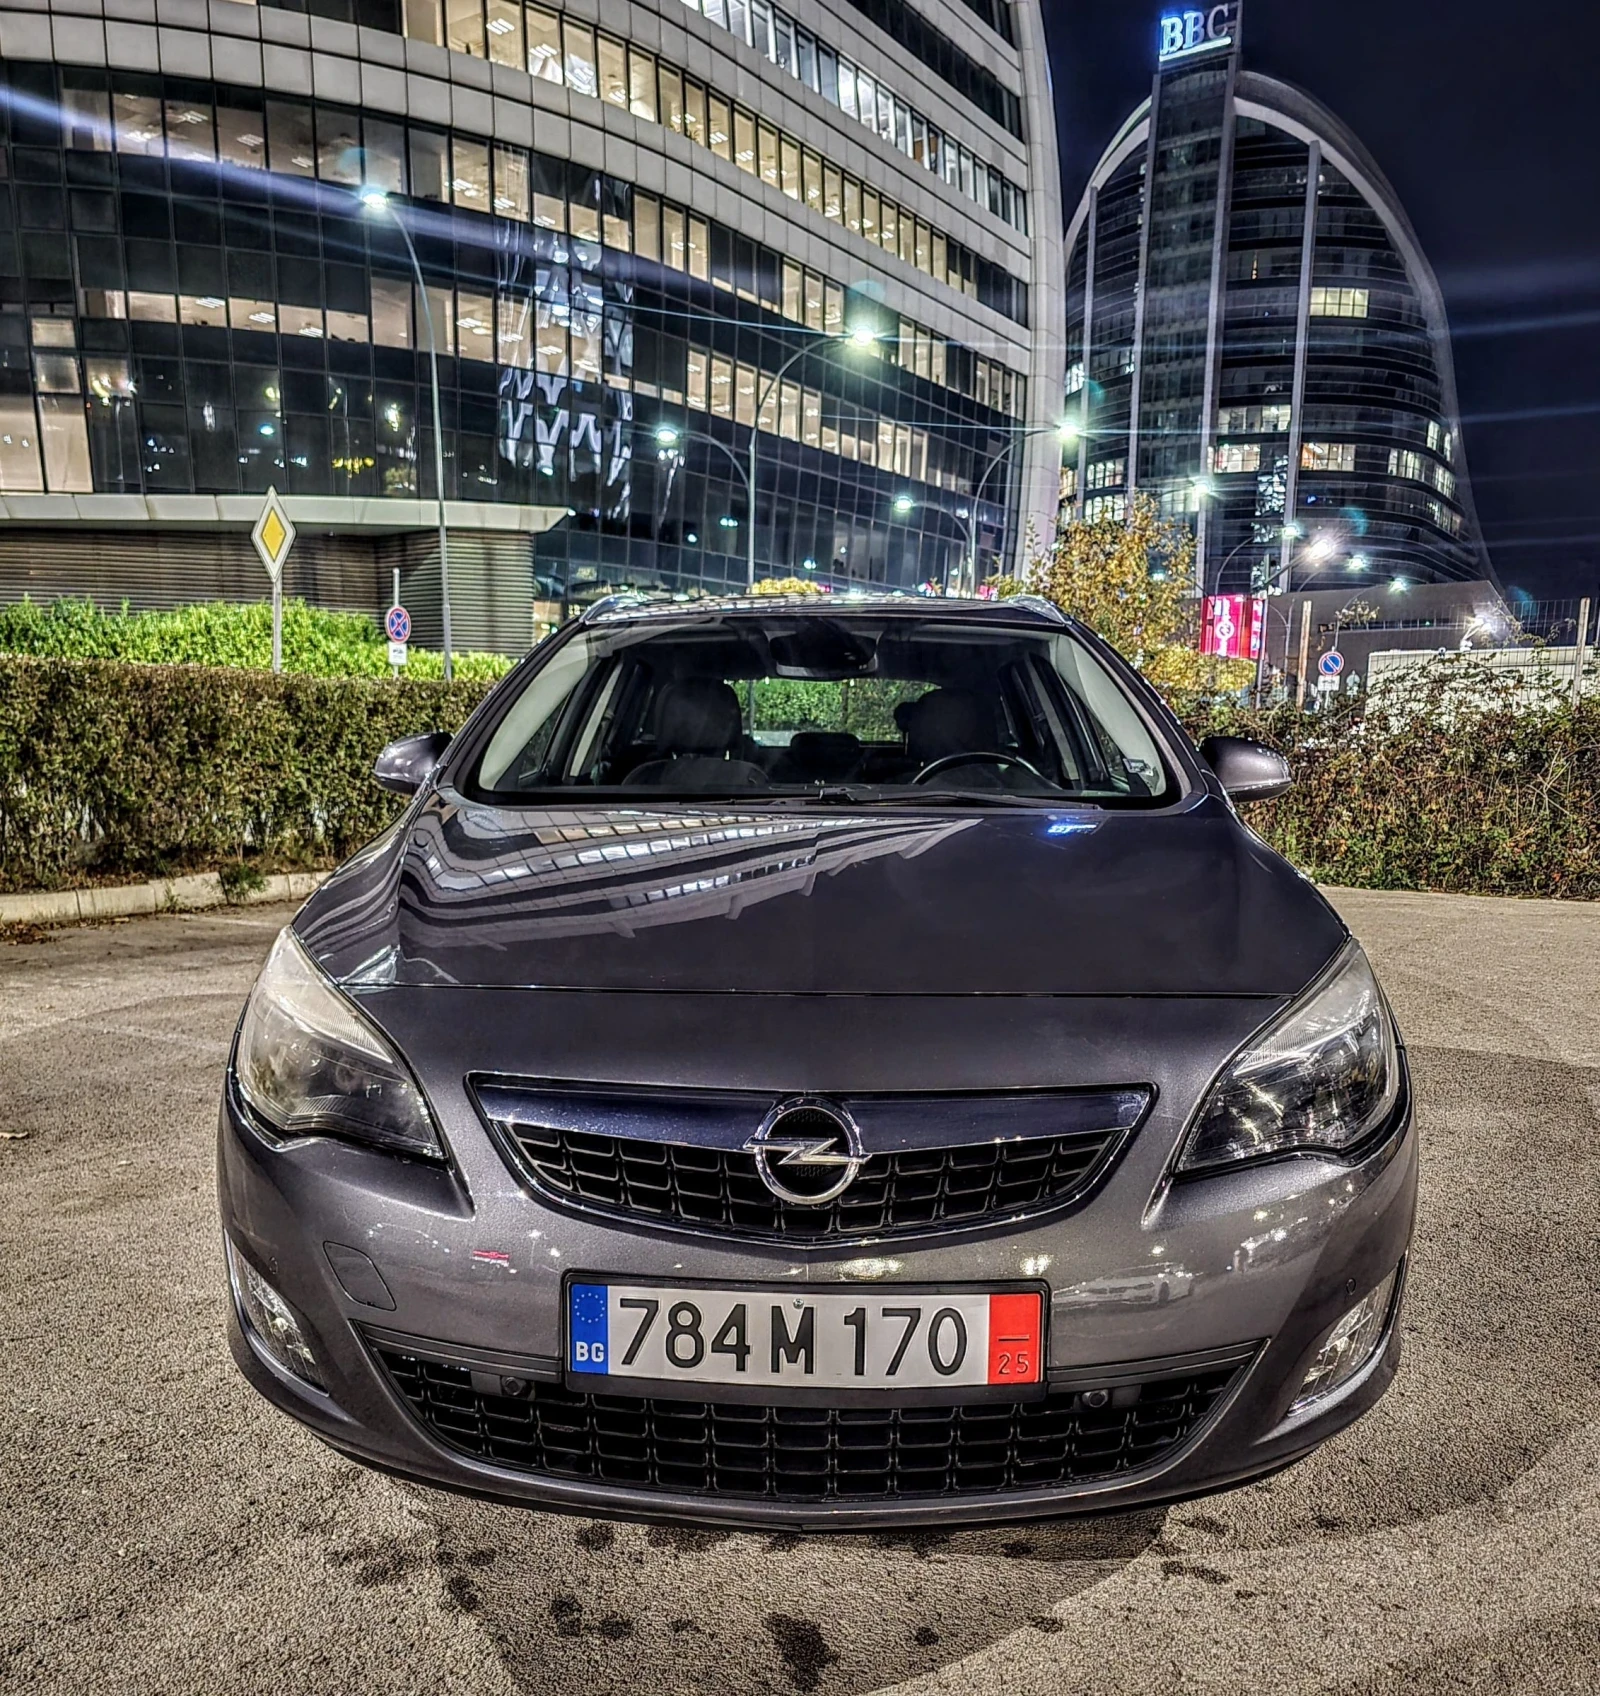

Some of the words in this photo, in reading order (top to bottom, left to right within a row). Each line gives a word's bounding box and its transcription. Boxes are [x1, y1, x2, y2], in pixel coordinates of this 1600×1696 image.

[1160, 3, 1229, 55] BBC
[575, 1341, 605, 1363] BG
[619, 1297, 751, 1372] 784
[771, 1305, 815, 1374] M
[843, 1307, 968, 1376] 170
[998, 1352, 1029, 1375] 25
